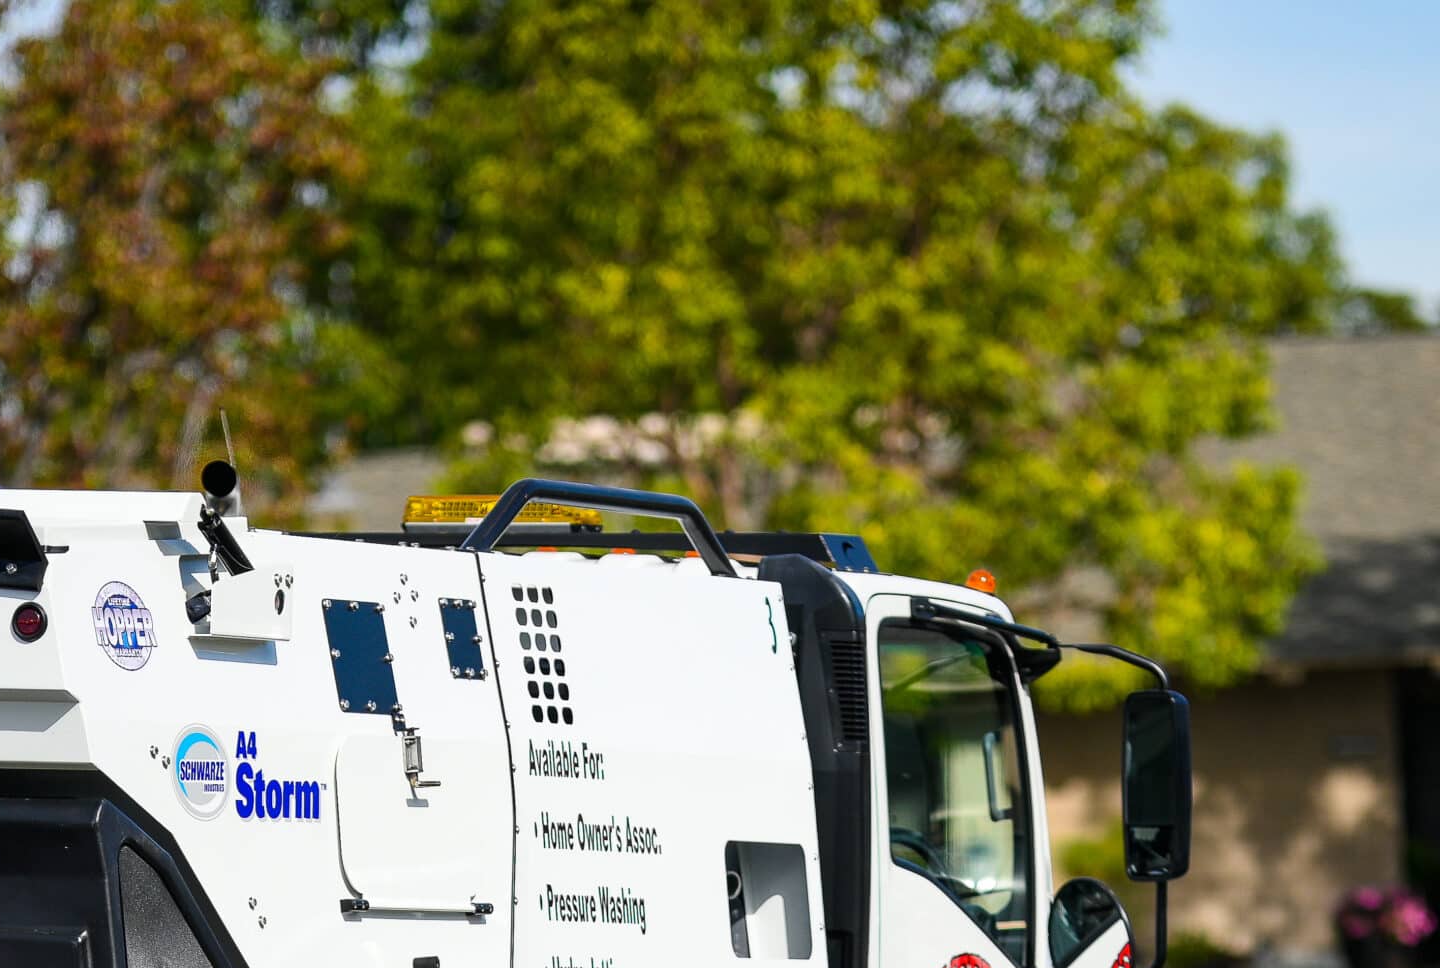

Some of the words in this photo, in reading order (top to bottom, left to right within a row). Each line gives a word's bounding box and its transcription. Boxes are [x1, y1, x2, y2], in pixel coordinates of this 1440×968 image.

[91, 606, 158, 647] HOPPER
[235, 731, 258, 760] A4
[528, 738, 580, 779] Available
[581, 742, 605, 780] For:
[179, 760, 225, 781] SCHWARZE
[234, 761, 320, 820] Storm
[541, 811, 575, 850] Home
[577, 812, 623, 853] Owner's
[625, 815, 662, 855] Assoc.
[546, 883, 597, 923] Pressure
[597, 886, 647, 935] Washing
